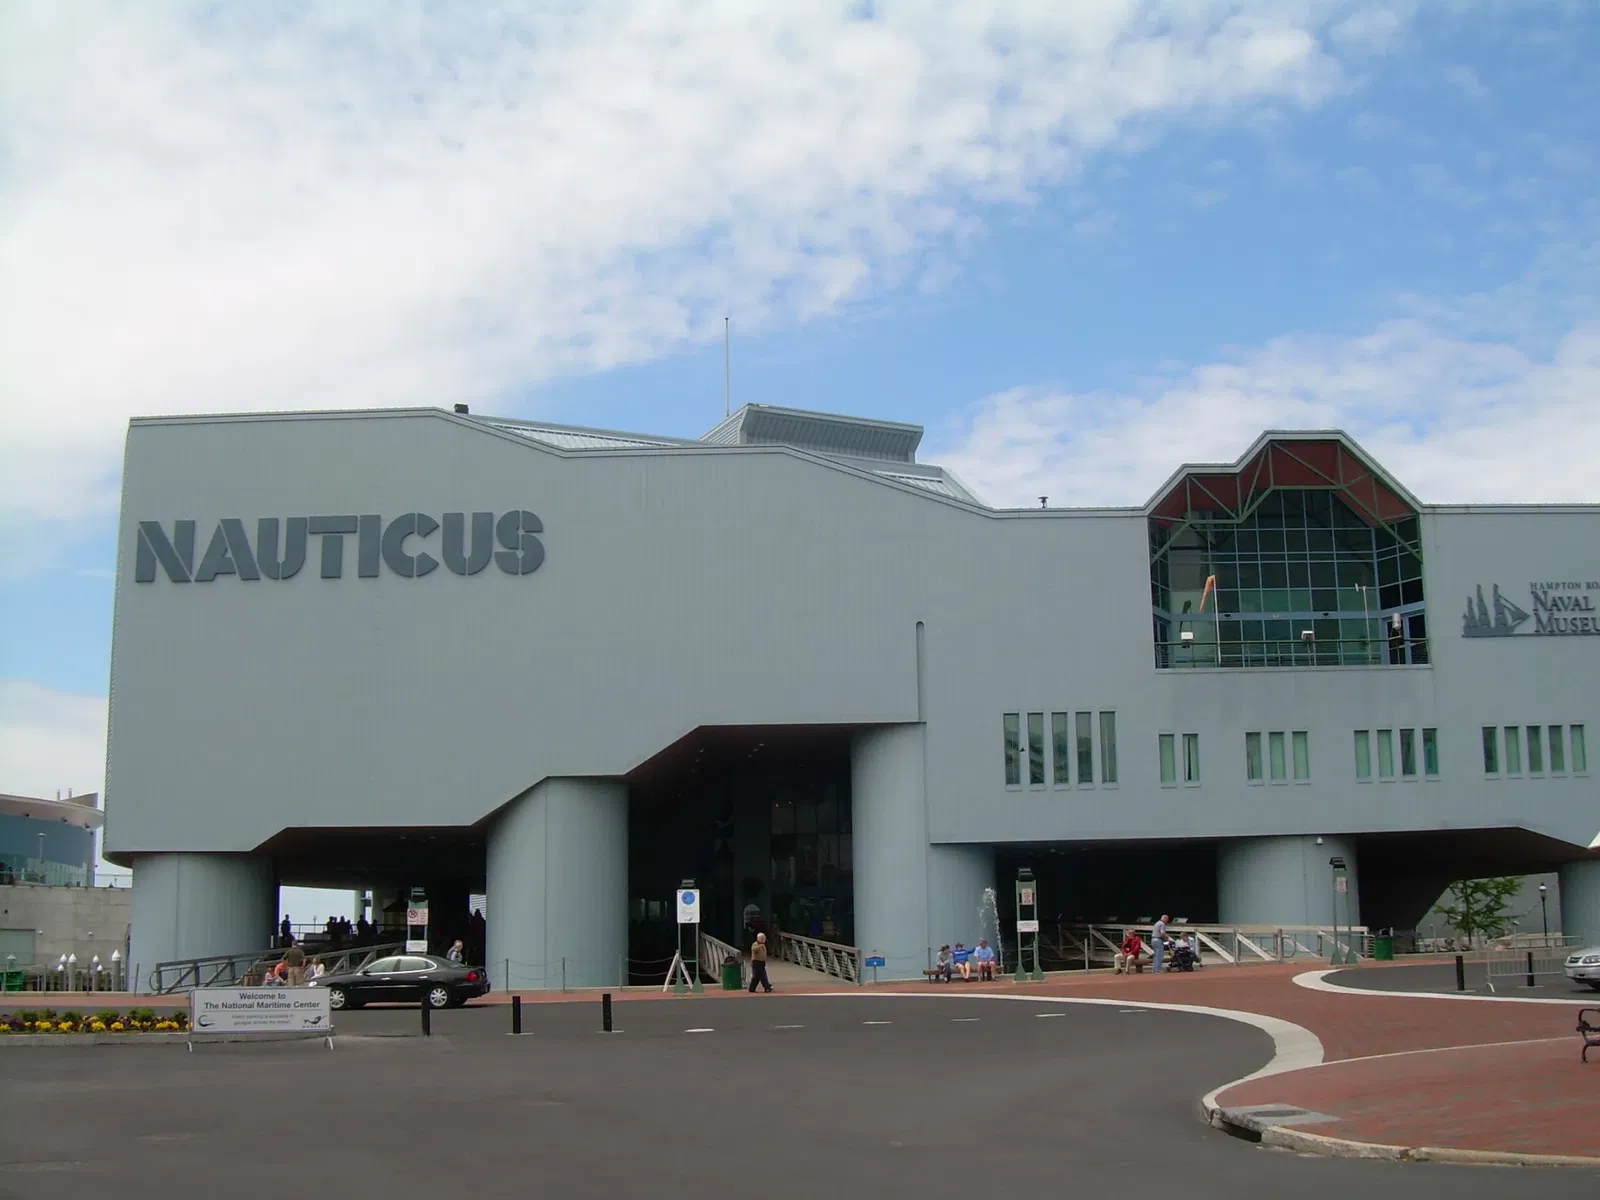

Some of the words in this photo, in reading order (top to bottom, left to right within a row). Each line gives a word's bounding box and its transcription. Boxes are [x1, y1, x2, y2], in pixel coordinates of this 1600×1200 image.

[135, 509, 546, 584] NAUTICUS
[1530, 581, 1581, 590] HAMPTON
[1586, 581, 1600, 590] RO
[1530, 590, 1596, 611] NAVAL
[239, 992, 276, 1000] Welcome
[278, 992, 286, 1000] to
[221, 1001, 254, 1009] National
[256, 1001, 291, 1009] Maritime
